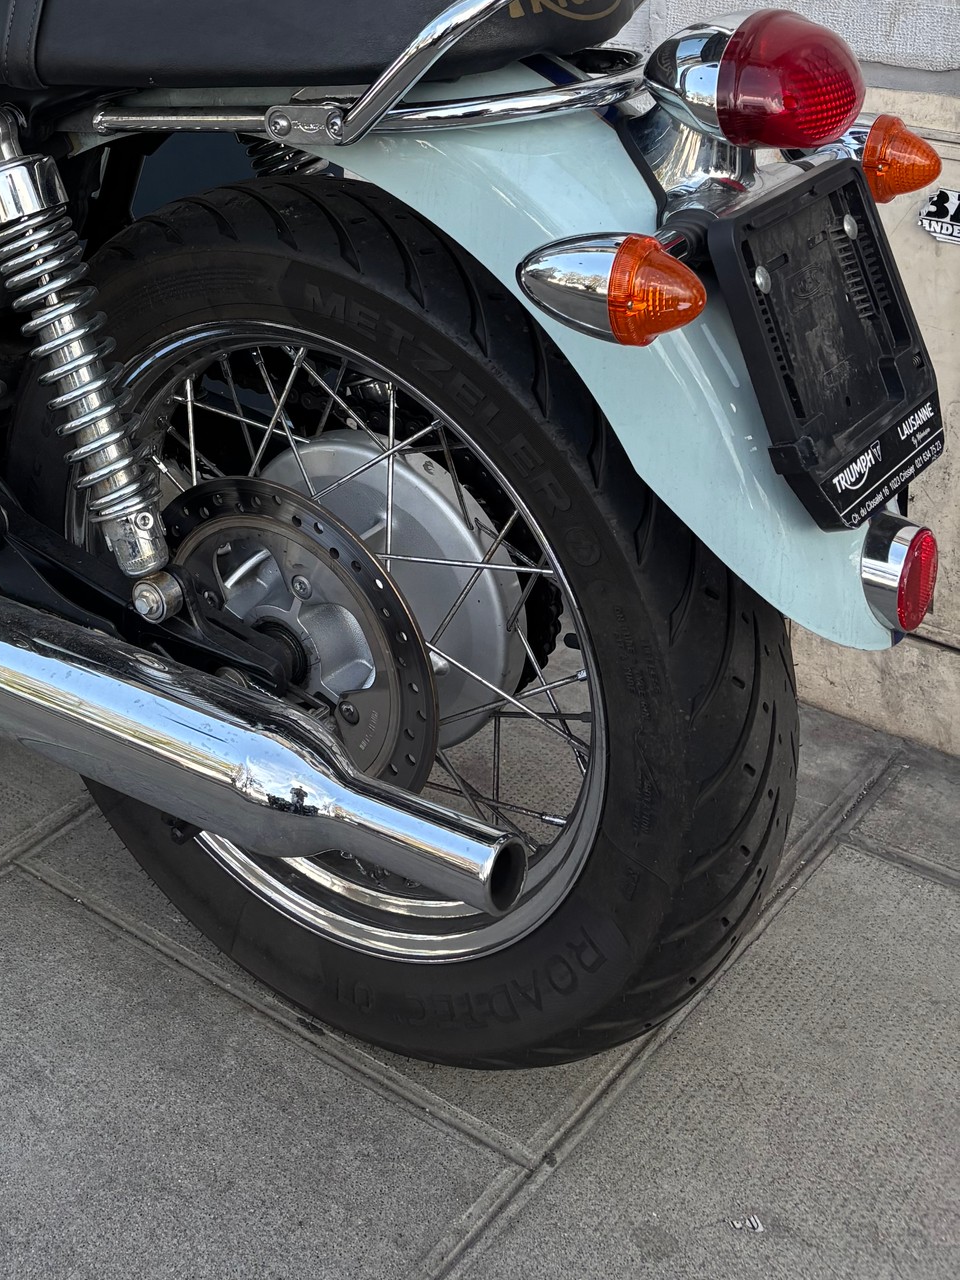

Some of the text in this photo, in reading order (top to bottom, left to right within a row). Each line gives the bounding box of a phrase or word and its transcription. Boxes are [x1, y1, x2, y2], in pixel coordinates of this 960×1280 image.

[303, 282, 573, 519] METZELER
[897, 401, 935, 440] LAUSANNE
[832, 451, 875, 493] TRIUMPH
[851, 513, 861, 524] Ch.
[860, 506, 867, 517] du
[882, 485, 890, 496] 16
[889, 477, 901, 491] 1023
[914, 457, 923, 470] 021
[922, 451, 931, 463] 634
[929, 445, 937, 456] 75
[935, 440, 942, 451] 23
